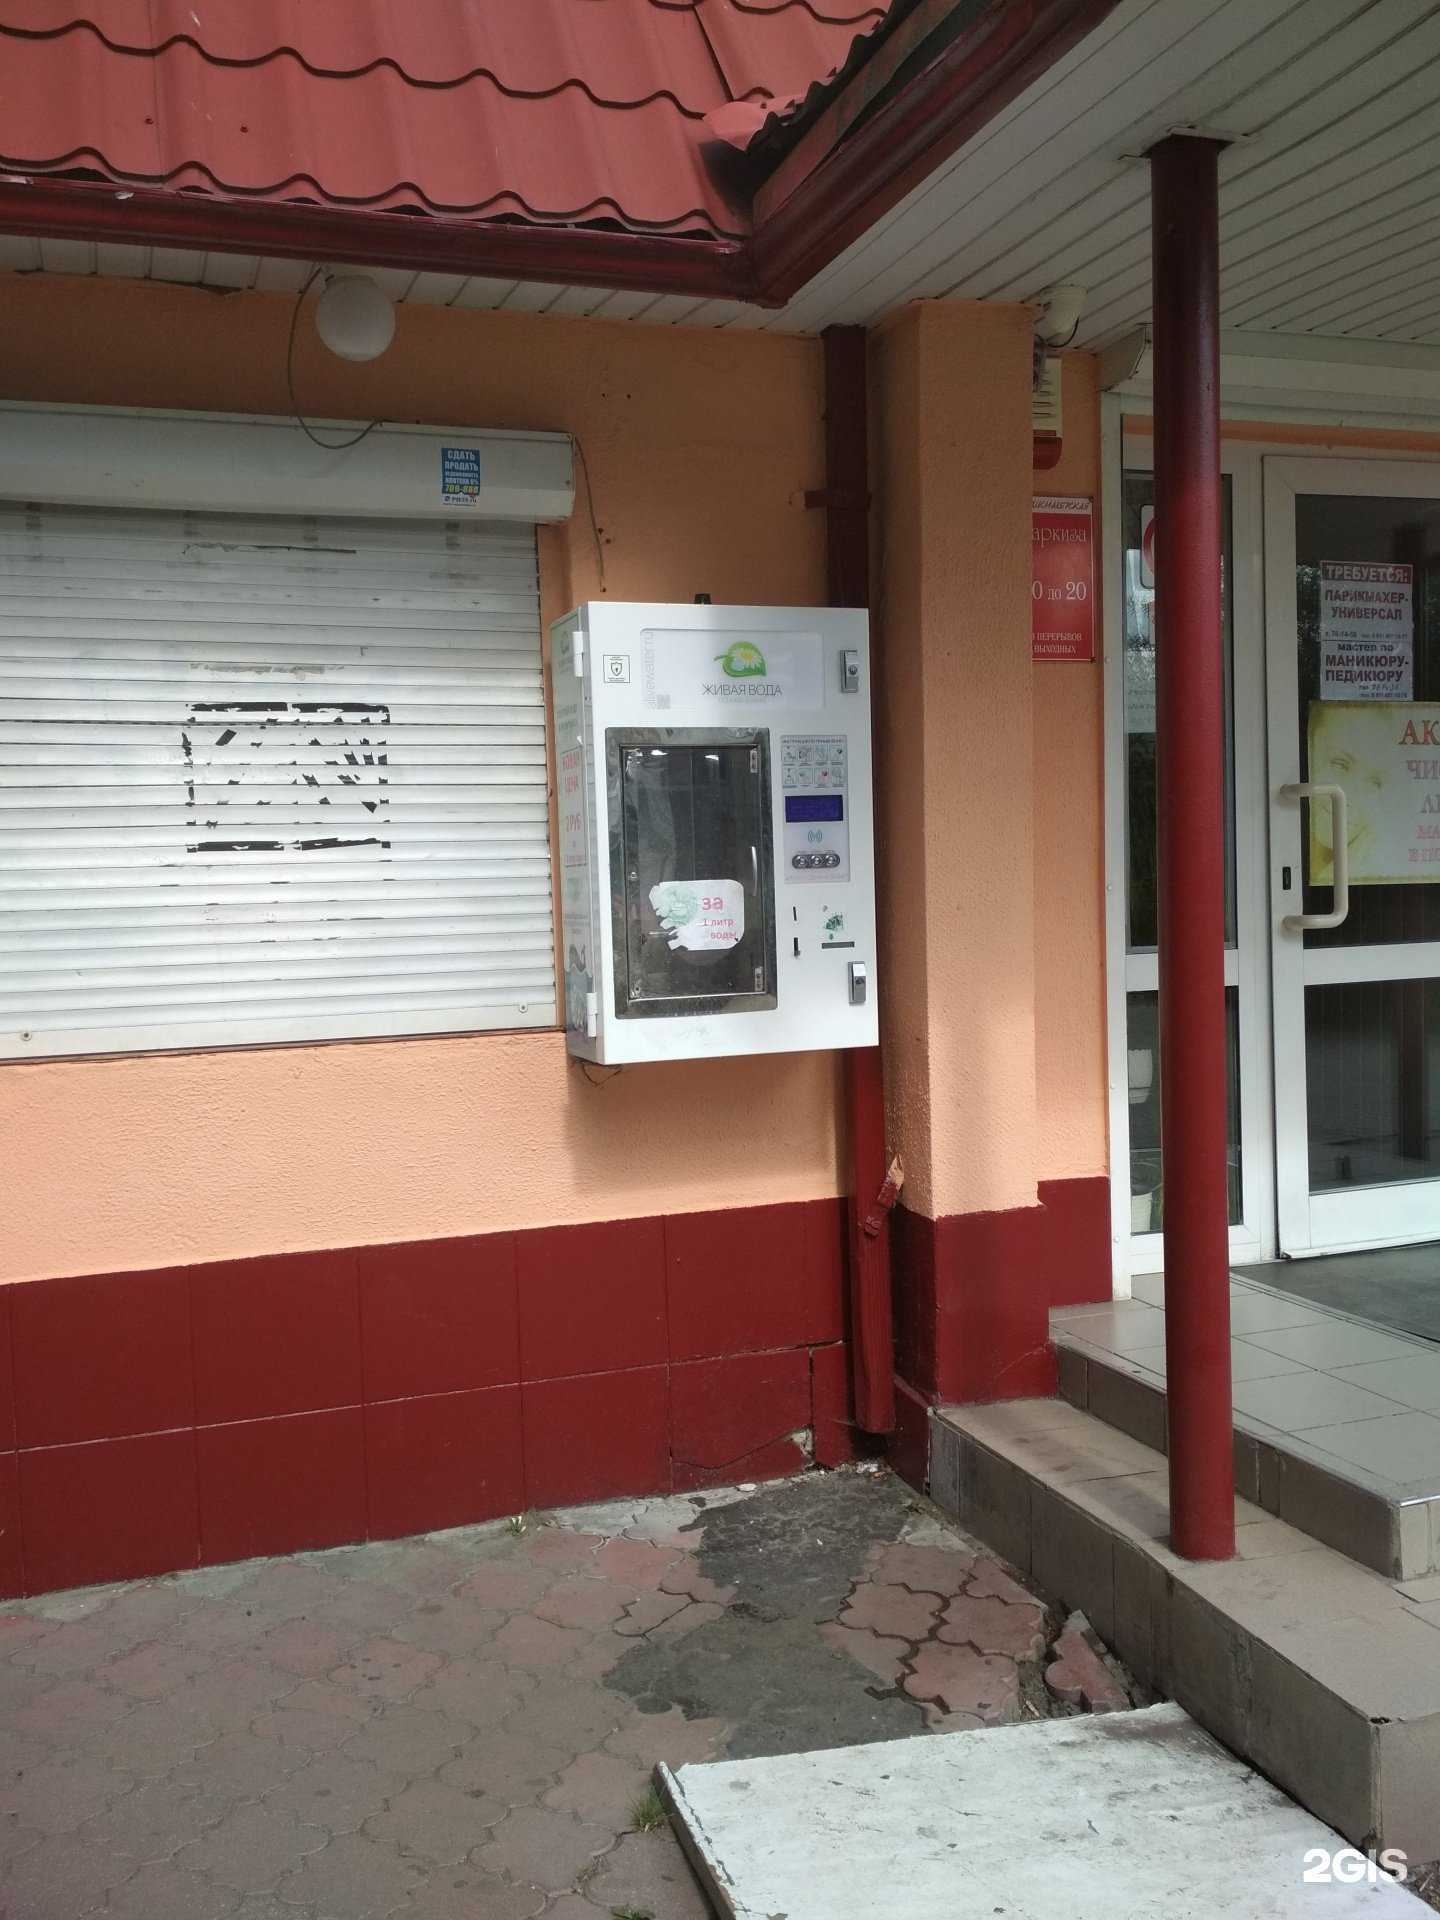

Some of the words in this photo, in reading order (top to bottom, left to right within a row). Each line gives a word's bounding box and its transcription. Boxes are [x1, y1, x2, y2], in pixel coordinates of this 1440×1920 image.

[447, 450, 476, 461] СДАТЬ
[444, 461, 479, 472] ПРОДАТЬ
[1032, 527, 1087, 548] аркиза
[1326, 565, 1408, 583] ТРЕБУЕТСЯ:
[1032, 580, 1043, 600] 0
[1065, 581, 1087, 600] 20
[1330, 606, 1403, 620] УНИВЕРСАЛ
[1325, 654, 1409, 668] МАНИКЮРУ-
[1325, 669, 1404, 684] ПЕДИКЮРУ
[702, 682, 746, 697] ЖИВАЯ
[748, 682, 783, 697] ВОДА
[1398, 718, 1440, 746] АК
[1406, 759, 1440, 780] ЧИ
[711, 919, 734, 927] литр
[710, 932, 737, 940] воды
